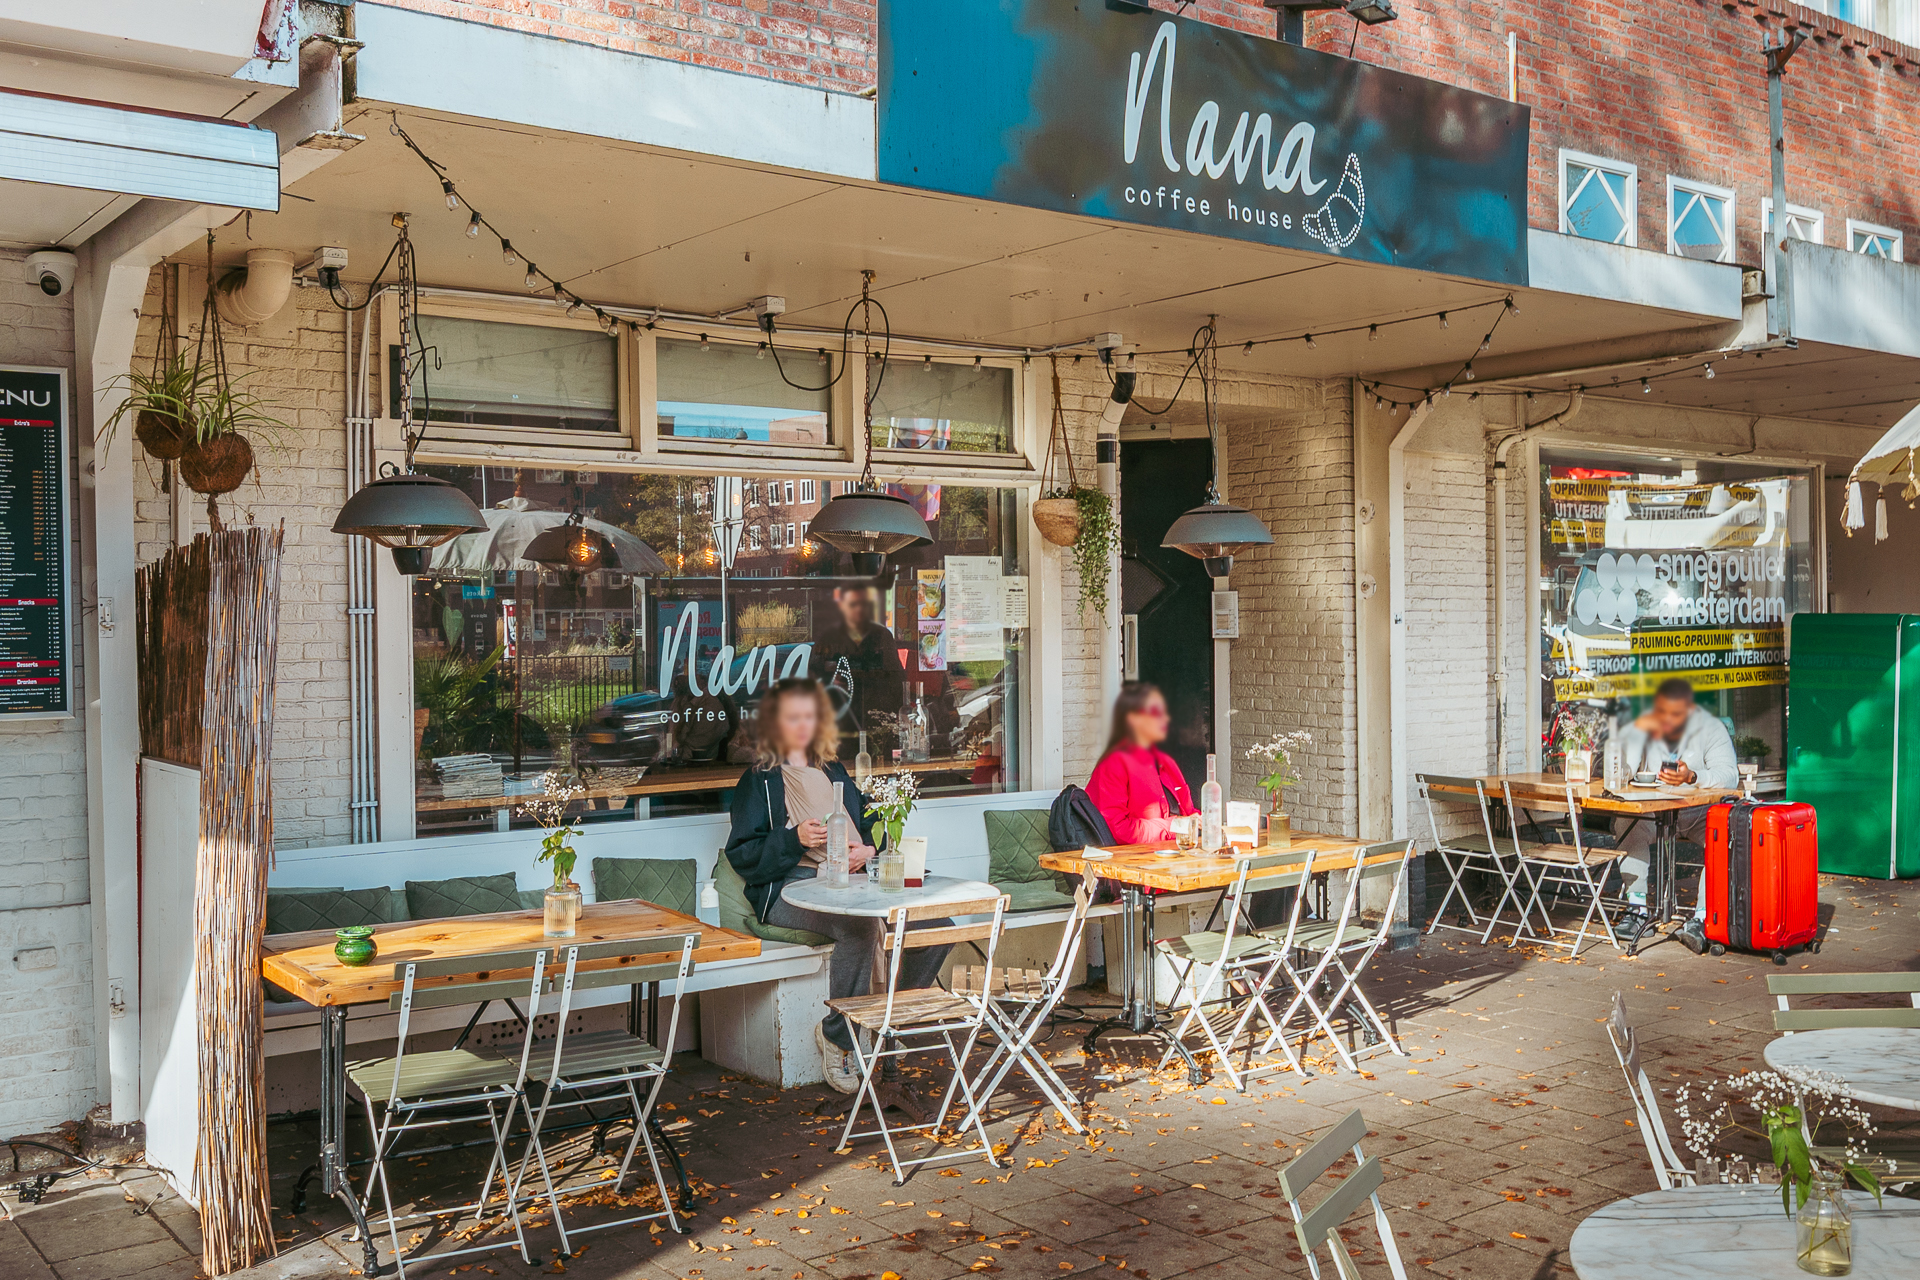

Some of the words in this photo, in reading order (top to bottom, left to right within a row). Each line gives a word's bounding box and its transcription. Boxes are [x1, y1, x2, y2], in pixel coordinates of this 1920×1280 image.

[1123, 20, 1327, 196] Nana
[1124, 185, 1211, 216] coffee
[1227, 198, 1293, 230] house
[0, 388, 52, 407] NU
[1658, 552, 1722, 591] smeg
[1726, 547, 1786, 583] outlet
[1658, 589, 1786, 625] amsterdam
[659, 601, 813, 699] Nana
[1645, 652, 1717, 671] UITVERKOOP
[1556, 683, 1570, 695] WIJ
[1572, 682, 1595, 694] GAAN
[1723, 672, 1735, 683] WIJ
[1735, 671, 1753, 682] GAAN
[659, 707, 727, 724] coffee
